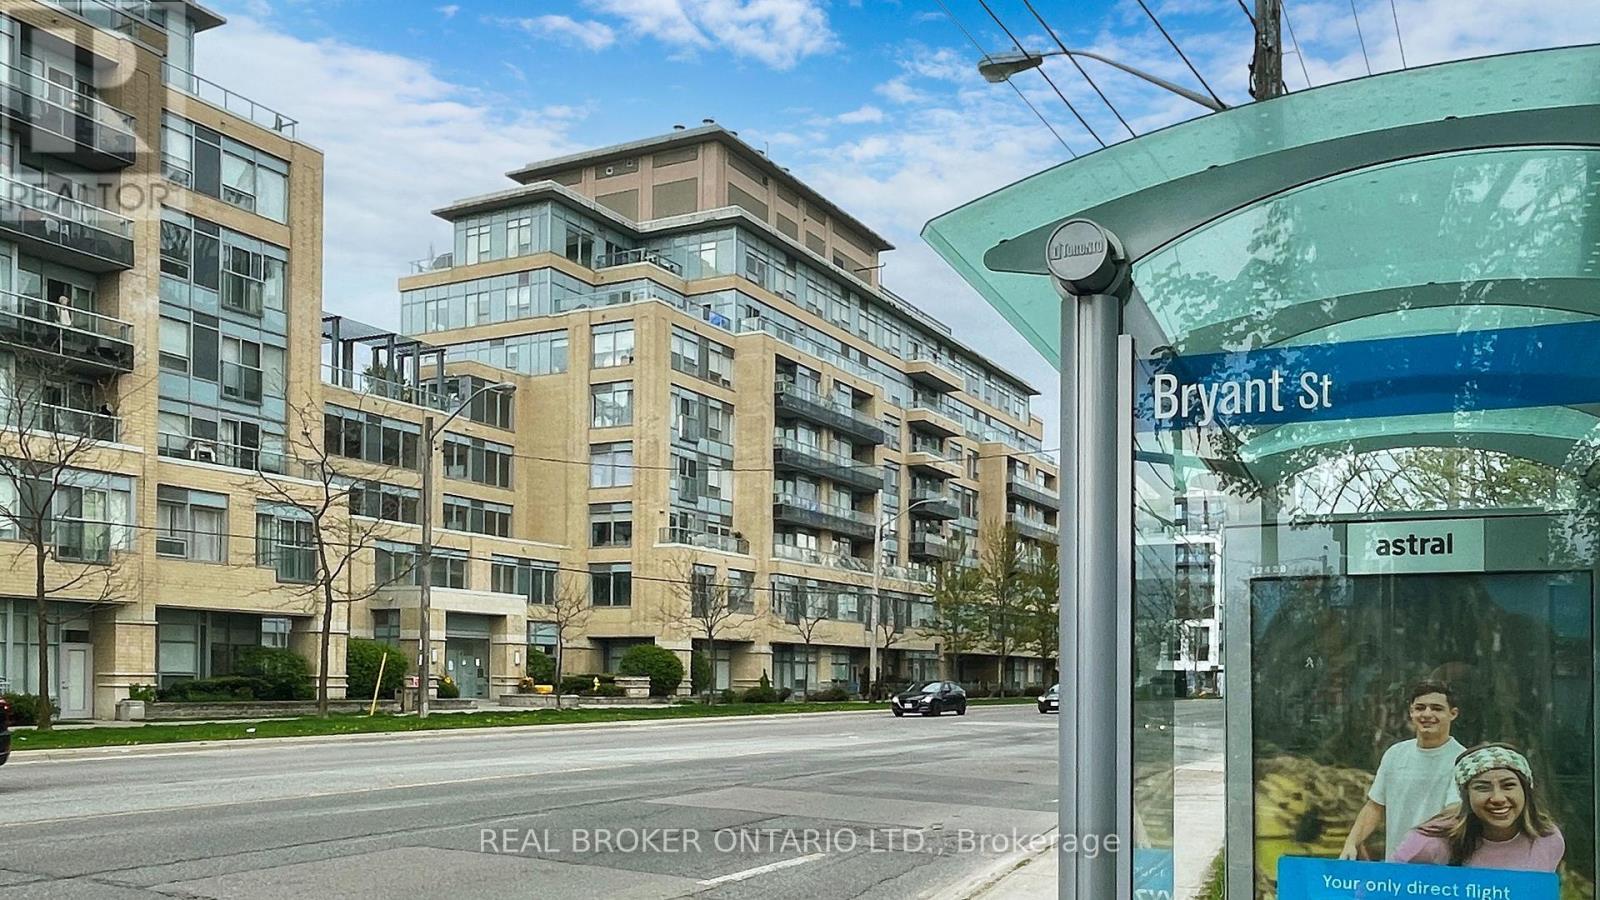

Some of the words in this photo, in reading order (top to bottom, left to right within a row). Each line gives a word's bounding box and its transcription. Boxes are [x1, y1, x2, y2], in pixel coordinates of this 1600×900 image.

[1154, 369, 1284, 427] Bryant
[1299, 371, 1333, 410] St
[1376, 533, 1453, 556] astral
[1323, 874, 1360, 891] Your
[1366, 880, 1401, 896] only
[1407, 880, 1460, 897] direct
[1465, 884, 1511, 900] flight
